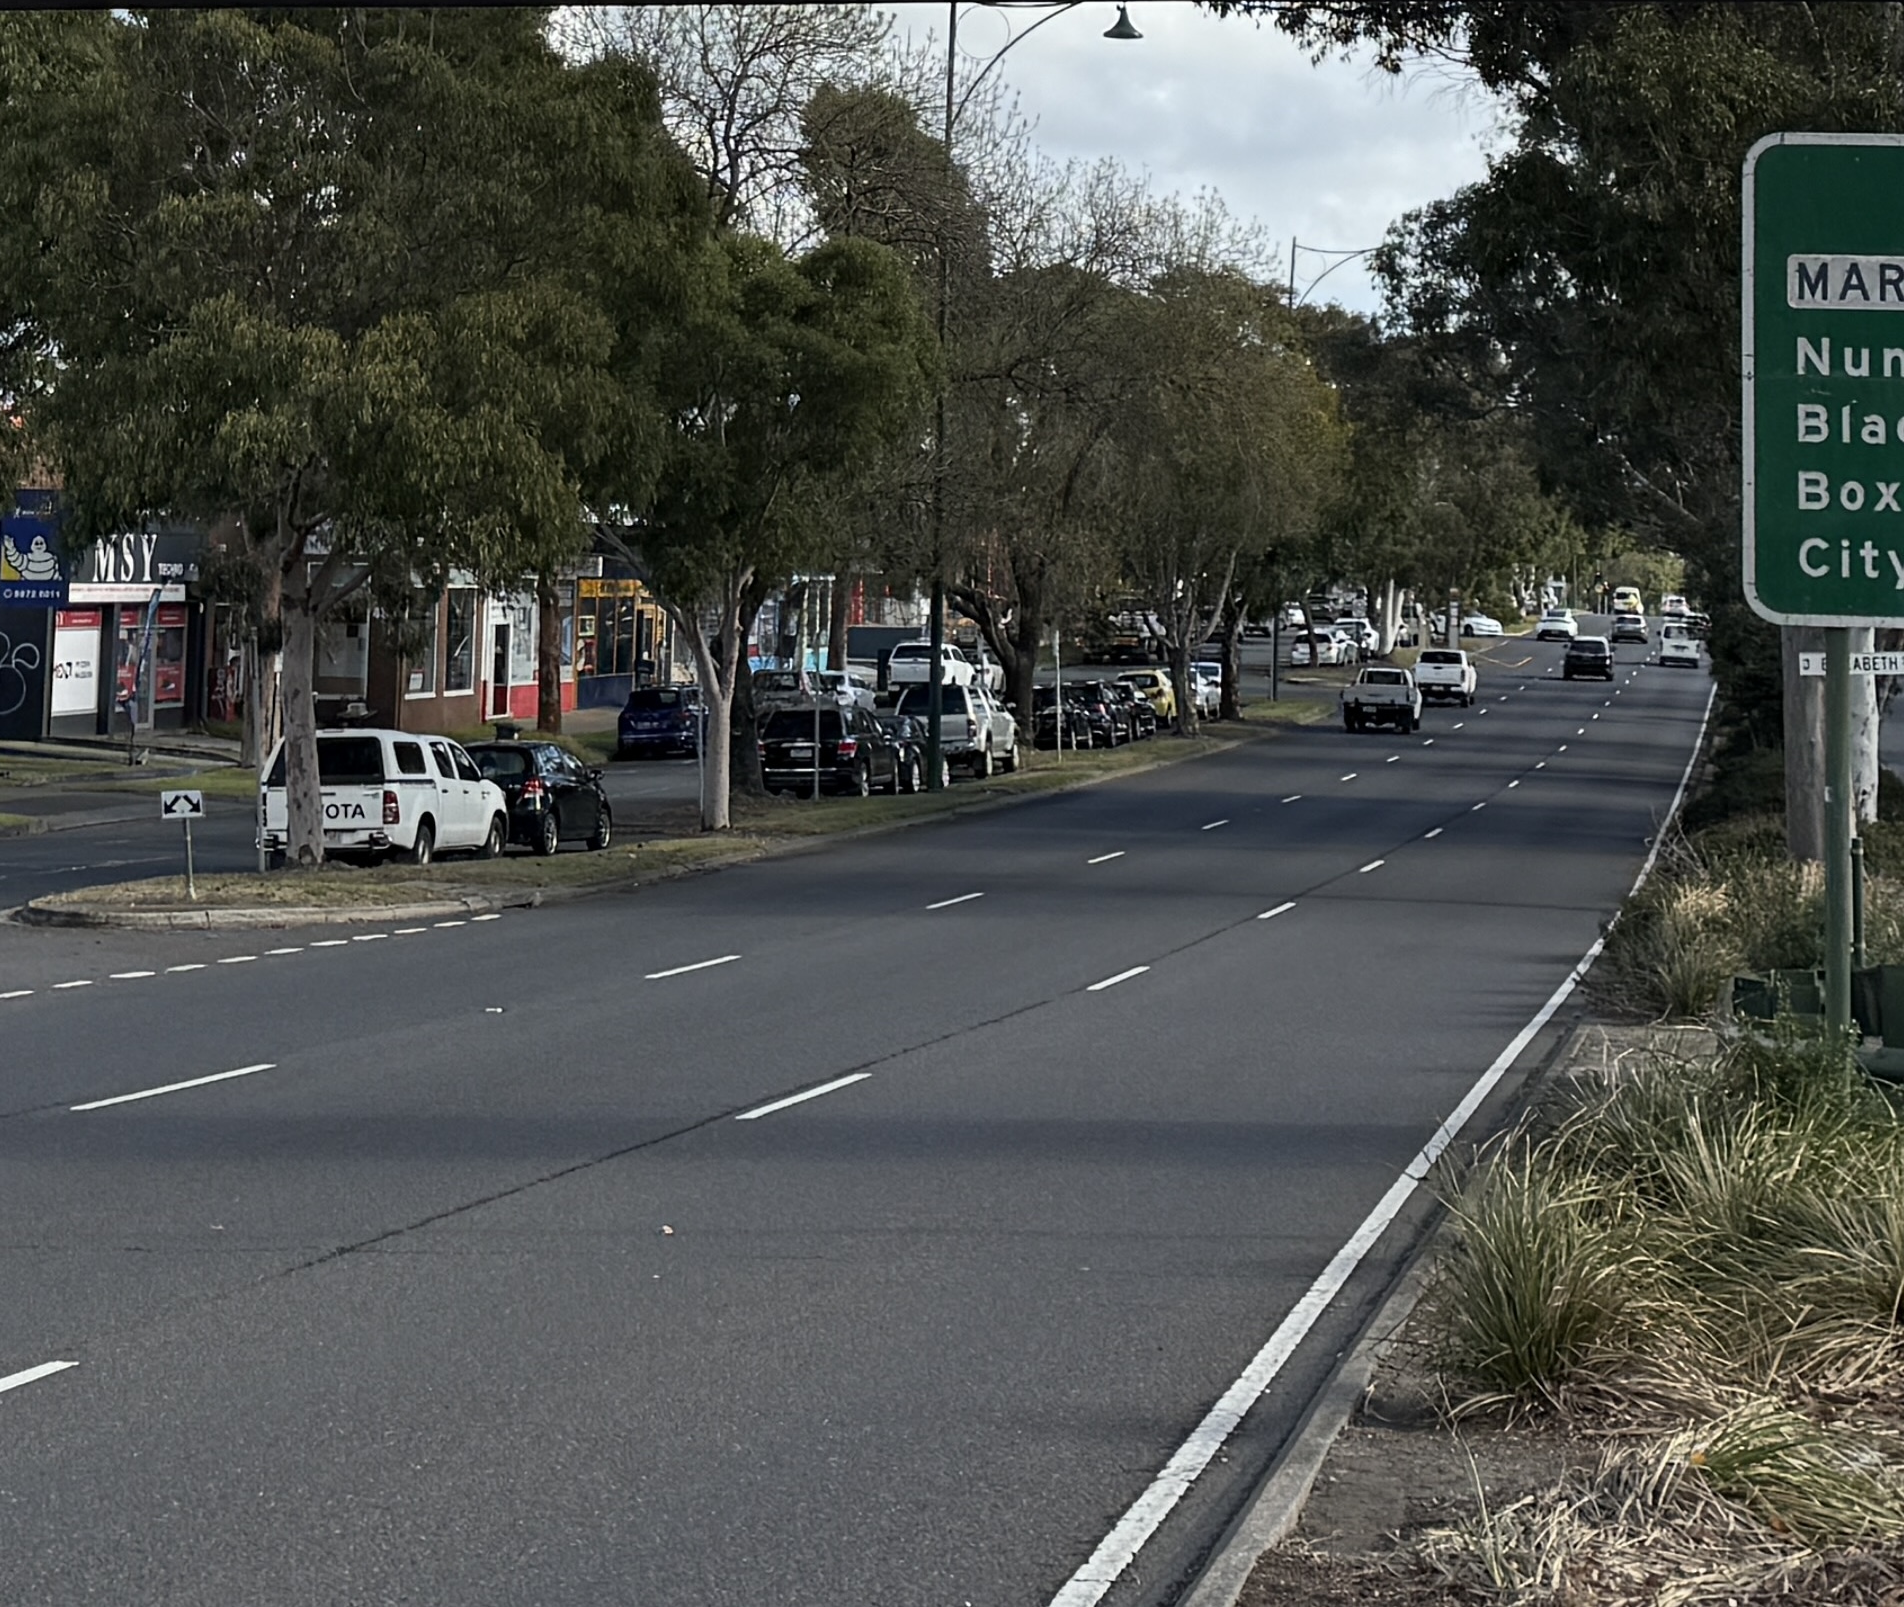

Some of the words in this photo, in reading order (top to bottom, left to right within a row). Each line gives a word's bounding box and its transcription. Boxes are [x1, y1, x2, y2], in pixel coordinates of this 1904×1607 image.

[1797, 471, 1902, 512] Box
[92, 532, 158, 582] MSY
[1821, 656, 1899, 672] EABETH
[325, 803, 366, 819] OTA
